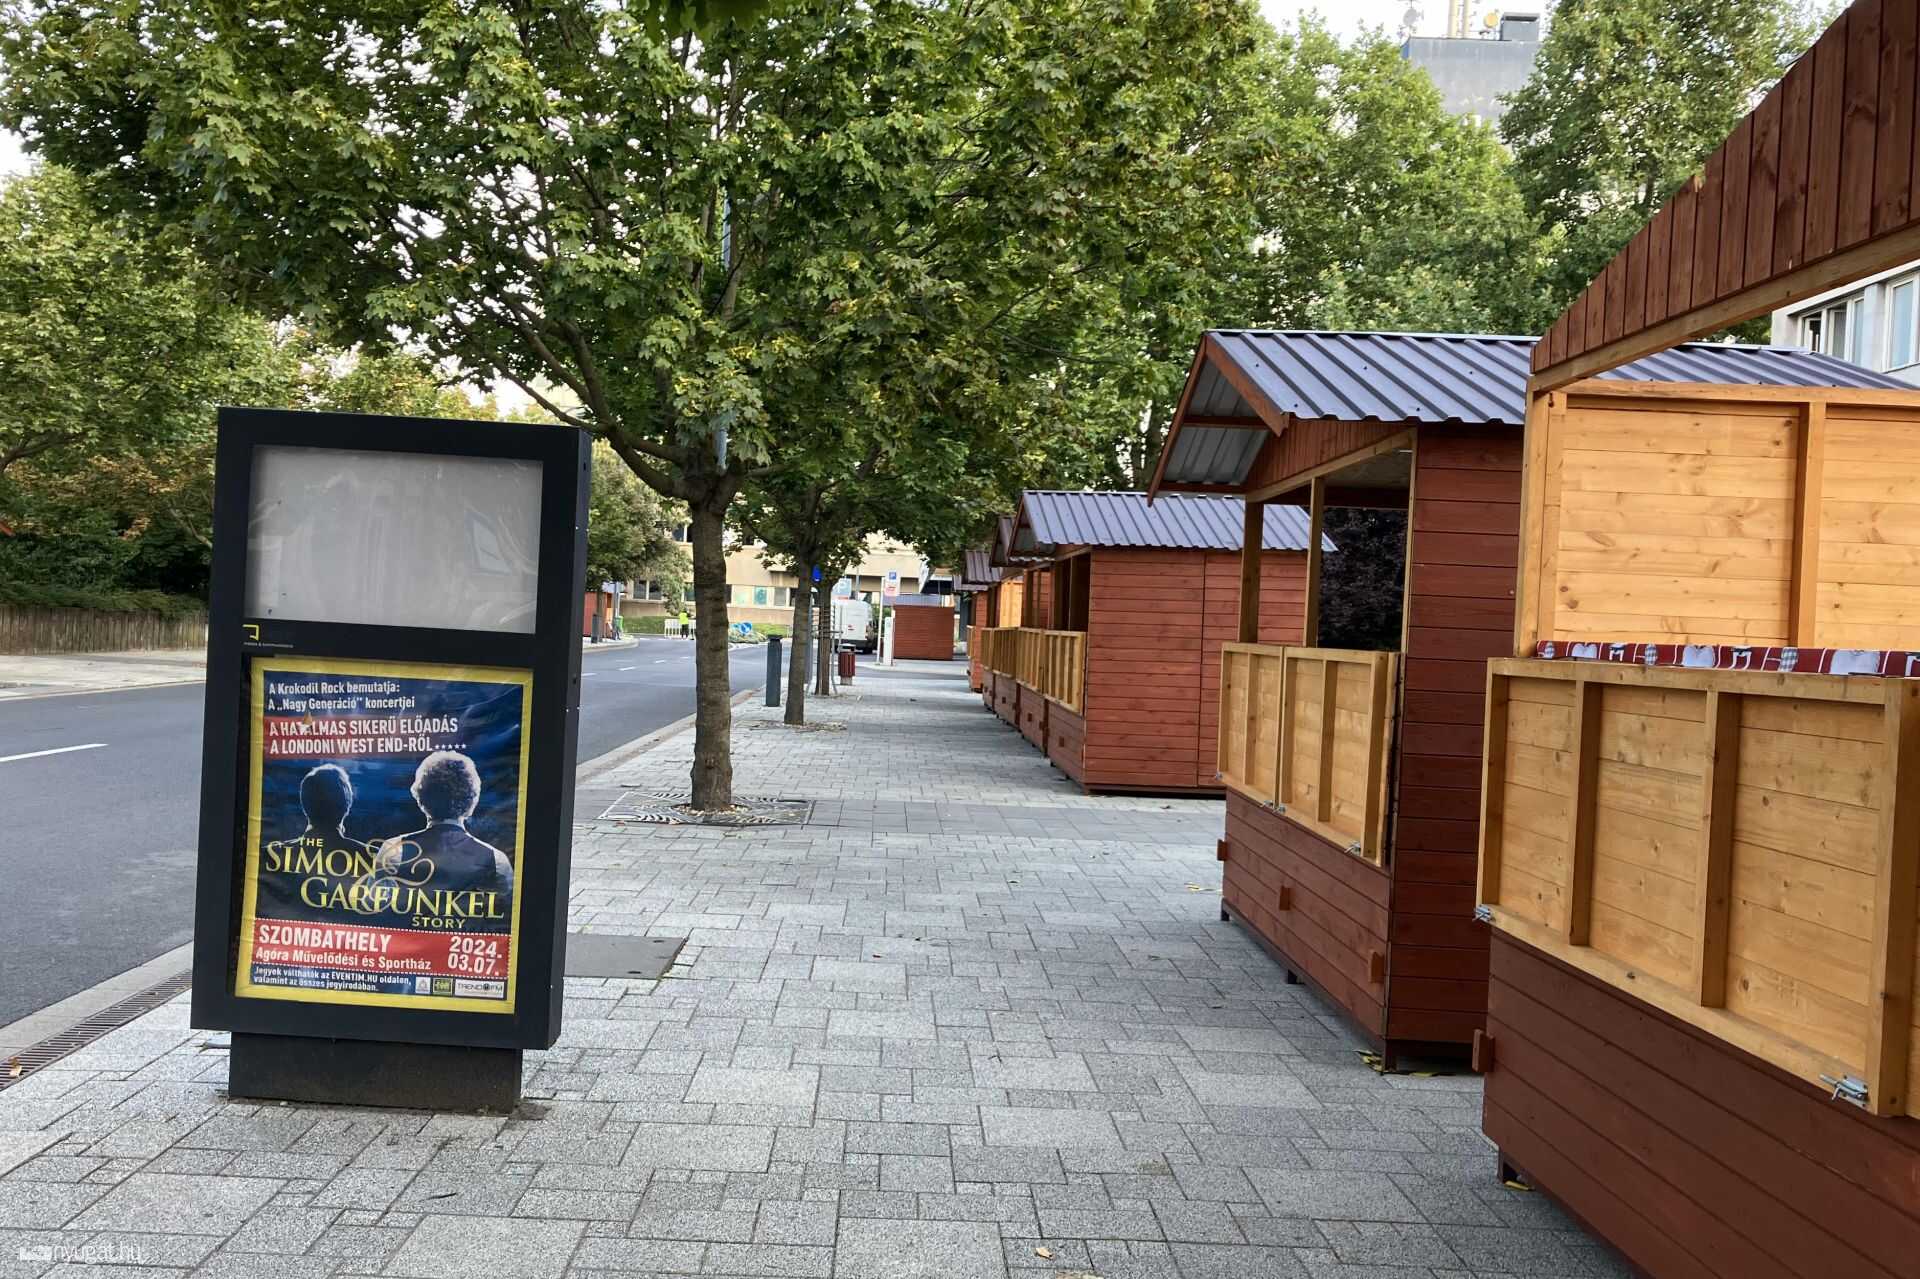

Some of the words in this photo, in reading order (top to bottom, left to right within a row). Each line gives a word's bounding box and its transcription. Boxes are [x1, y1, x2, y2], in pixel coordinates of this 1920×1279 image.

[269, 683, 276, 695] A
[278, 681, 319, 695] Krokodil
[321, 681, 345, 694] Rock
[347, 680, 400, 695] bemutatja:
[268, 698, 276, 711] A
[365, 696, 415, 710] koncertjei
[269, 721, 279, 737] A
[400, 714, 458, 734] ELŐADÁS
[269, 739, 279, 755] A
[282, 738, 335, 754] LONDONI
[337, 738, 375, 753] WEST
[298, 836, 324, 847] THE
[265, 841, 378, 878] SIMON
[300, 876, 504, 919] GARFUNKEL
[412, 917, 467, 929] STORY
[259, 925, 392, 953] SZOMBATHELY
[449, 936, 503, 958] 2024.
[255, 946, 289, 962] Agóra
[361, 955, 375, 968] és
[378, 955, 432, 970] Sportház
[447, 953, 500, 976] 03.07.
[253, 975, 288, 985] valamint
[289, 978, 298, 986] az
[299, 978, 325, 988] összes
[254, 966, 282, 977] Jegyek
[320, 971, 330, 979] az
[331, 971, 378, 983] EVENTIM.HU
